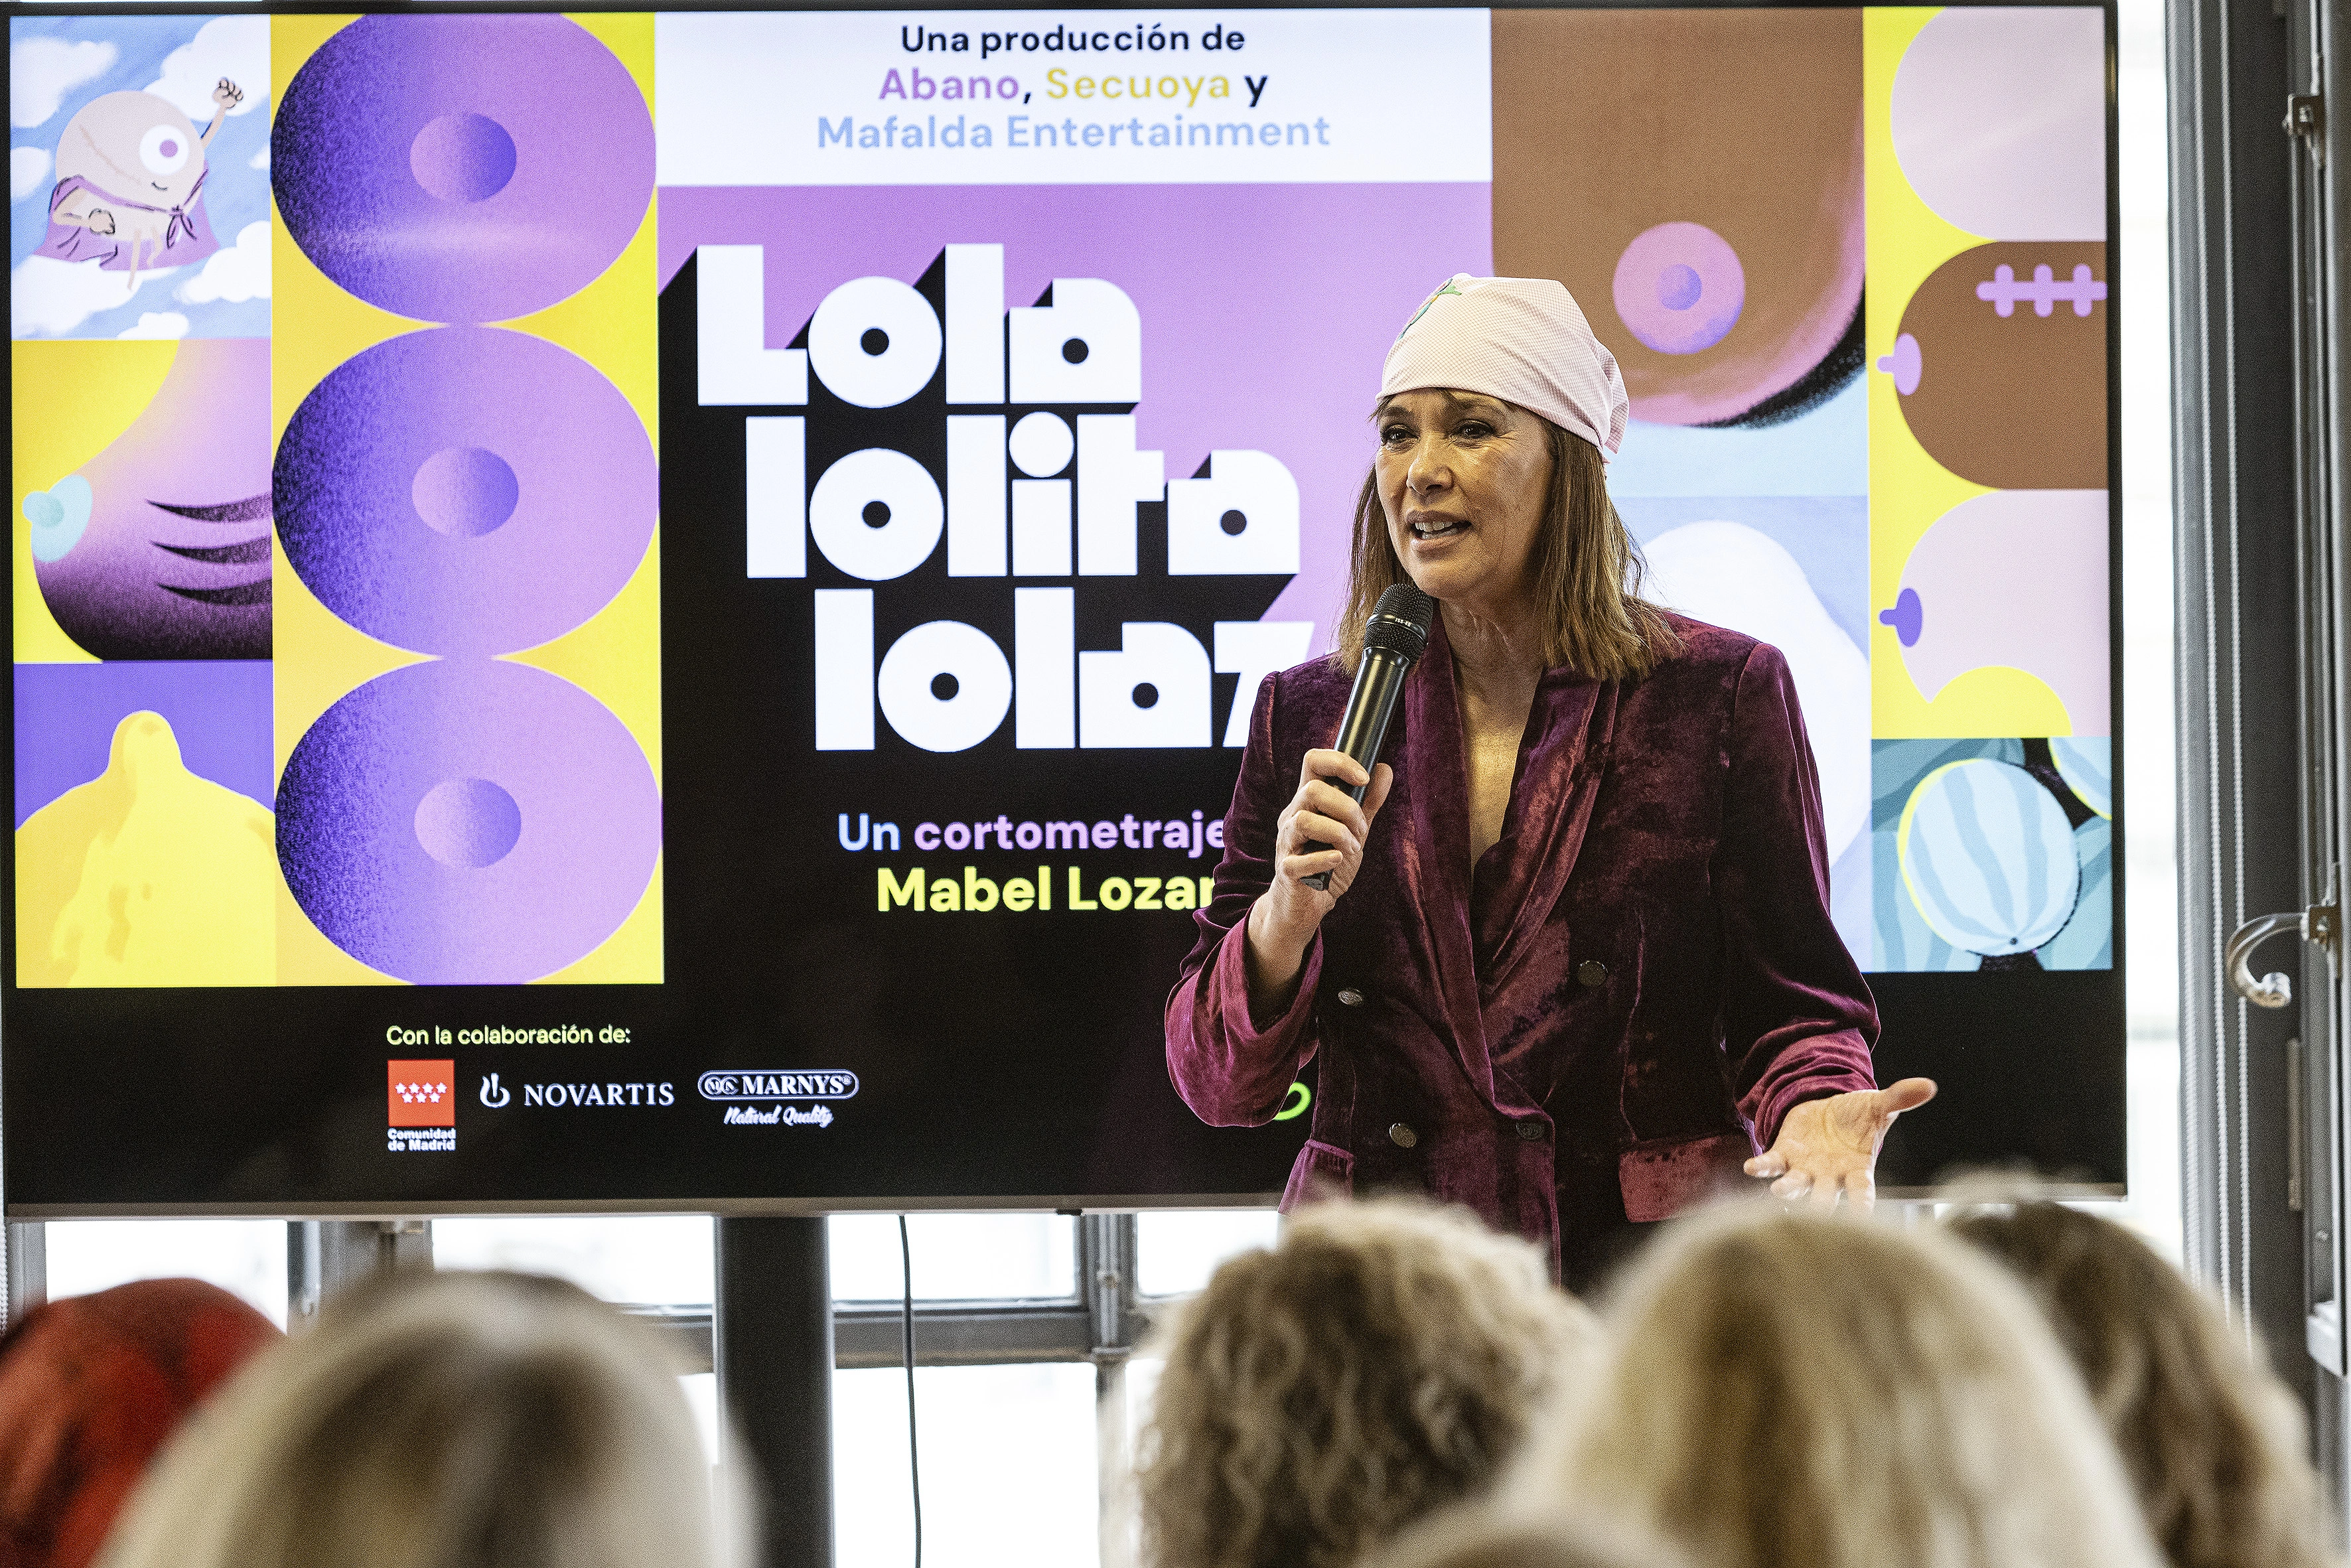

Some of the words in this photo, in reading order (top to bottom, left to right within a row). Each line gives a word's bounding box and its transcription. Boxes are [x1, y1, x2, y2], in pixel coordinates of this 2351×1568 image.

[901, 25, 969, 52] Una
[981, 23, 1190, 60] producción
[1201, 24, 1246, 51] de
[879, 67, 1033, 105] Abano,
[1046, 68, 1230, 107] Secuoya
[1244, 74, 1268, 108] y
[818, 115, 993, 149] Mafalda
[1007, 114, 1330, 148] Entertainment
[697, 243, 1141, 409] Lola
[746, 411, 1300, 581] lolita
[839, 813, 901, 852] Un
[914, 809, 1225, 858] cortometraje
[877, 865, 1051, 912] Mabel
[386, 1025, 429, 1045] Con
[435, 1025, 453, 1045] la
[457, 1025, 593, 1044] colaboración
[599, 1025, 631, 1044] de:
[523, 1082, 676, 1107] NOVARTIS
[741, 1075, 845, 1095] MARNYS
[388, 1128, 457, 1139] Comunidad
[723, 1104, 782, 1125] Natural
[782, 1104, 833, 1128] Quality
[388, 1139, 405, 1151] de
[408, 1139, 457, 1151] Madrid
